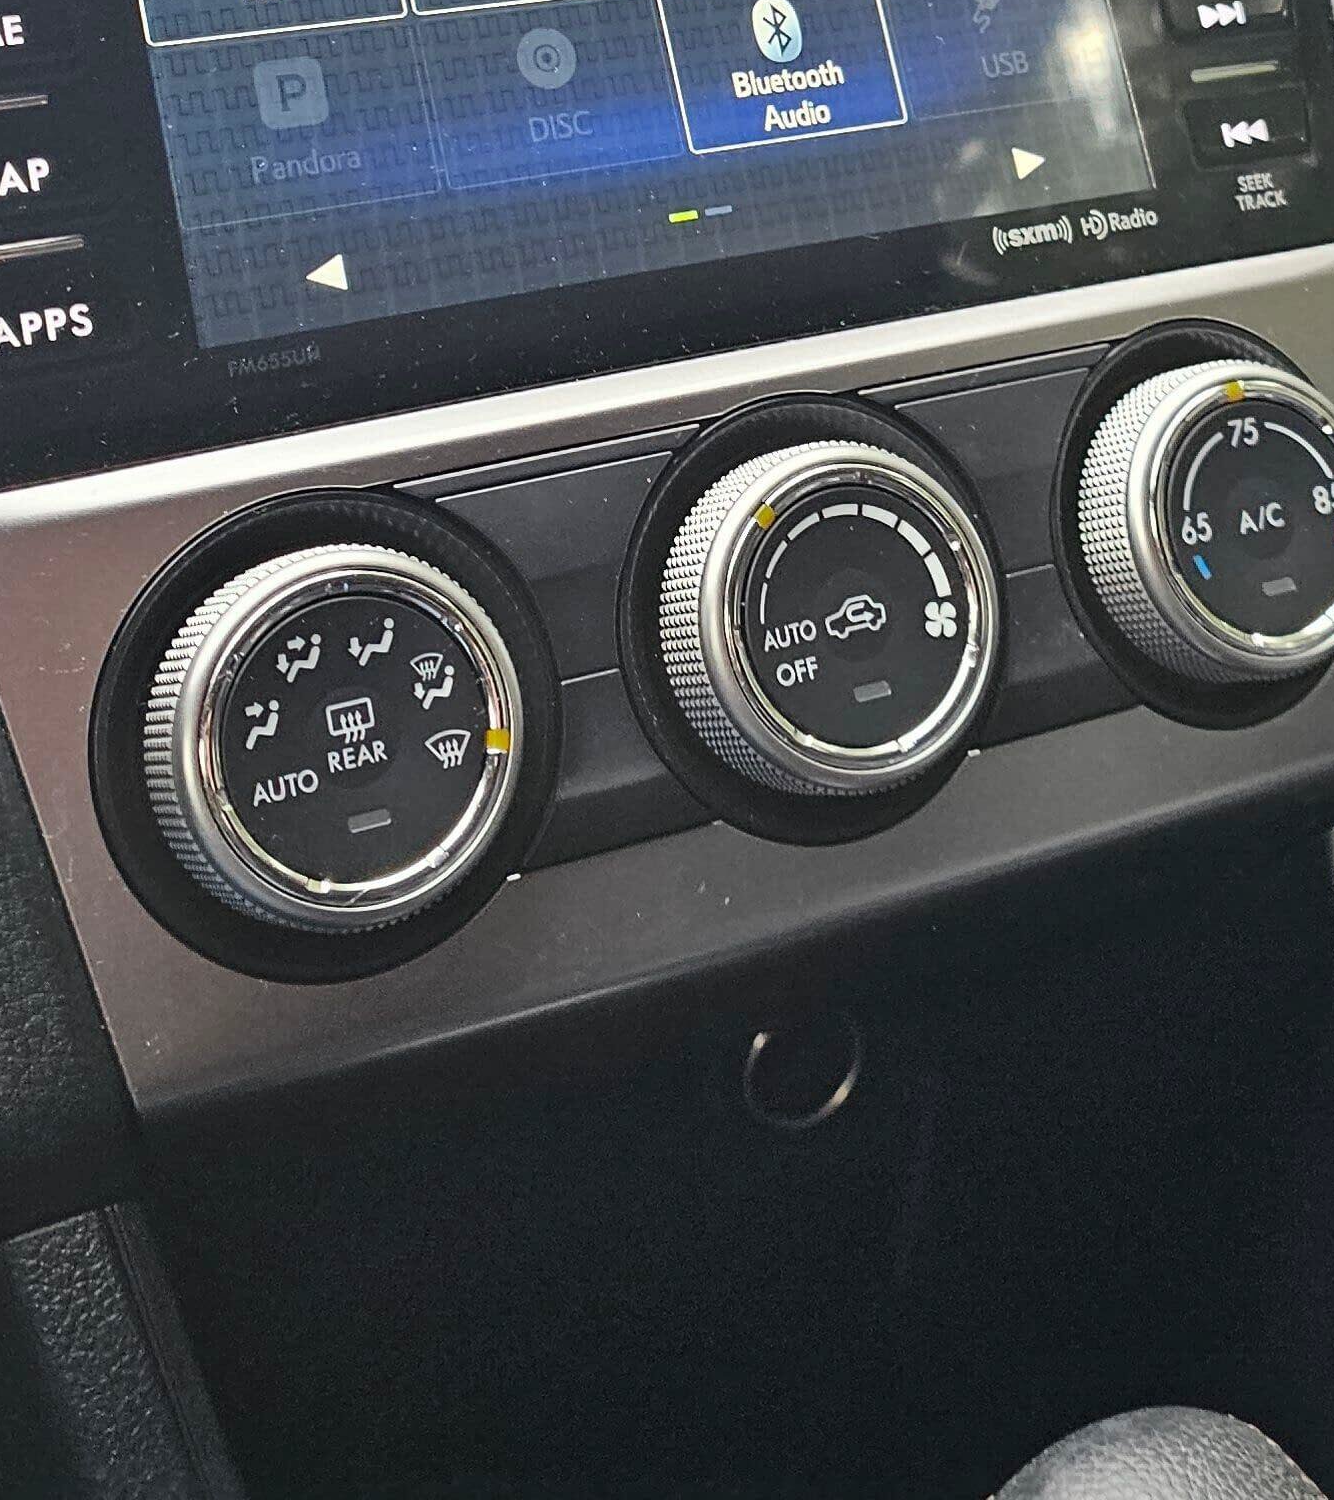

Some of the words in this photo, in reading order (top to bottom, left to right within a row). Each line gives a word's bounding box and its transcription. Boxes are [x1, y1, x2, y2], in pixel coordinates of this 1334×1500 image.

[732, 60, 845, 99] Bluetooth
[982, 50, 1029, 79] USB
[278, 73, 307, 112] P
[529, 111, 595, 143] DISC
[764, 100, 831, 132] Audio
[251, 147, 362, 183] Pandora
[1236, 172, 1275, 193] SEEK
[1235, 190, 1287, 212] TRACK
[1108, 207, 1159, 232] Radio
[1227, 417, 1259, 448] 75
[1181, 511, 1213, 545] 65
[1239, 502, 1285, 535] A/C
[764, 619, 817, 652] AUTO
[776, 656, 818, 687] OFF
[327, 740, 388, 774] REAR
[253, 769, 319, 807] AUTO
